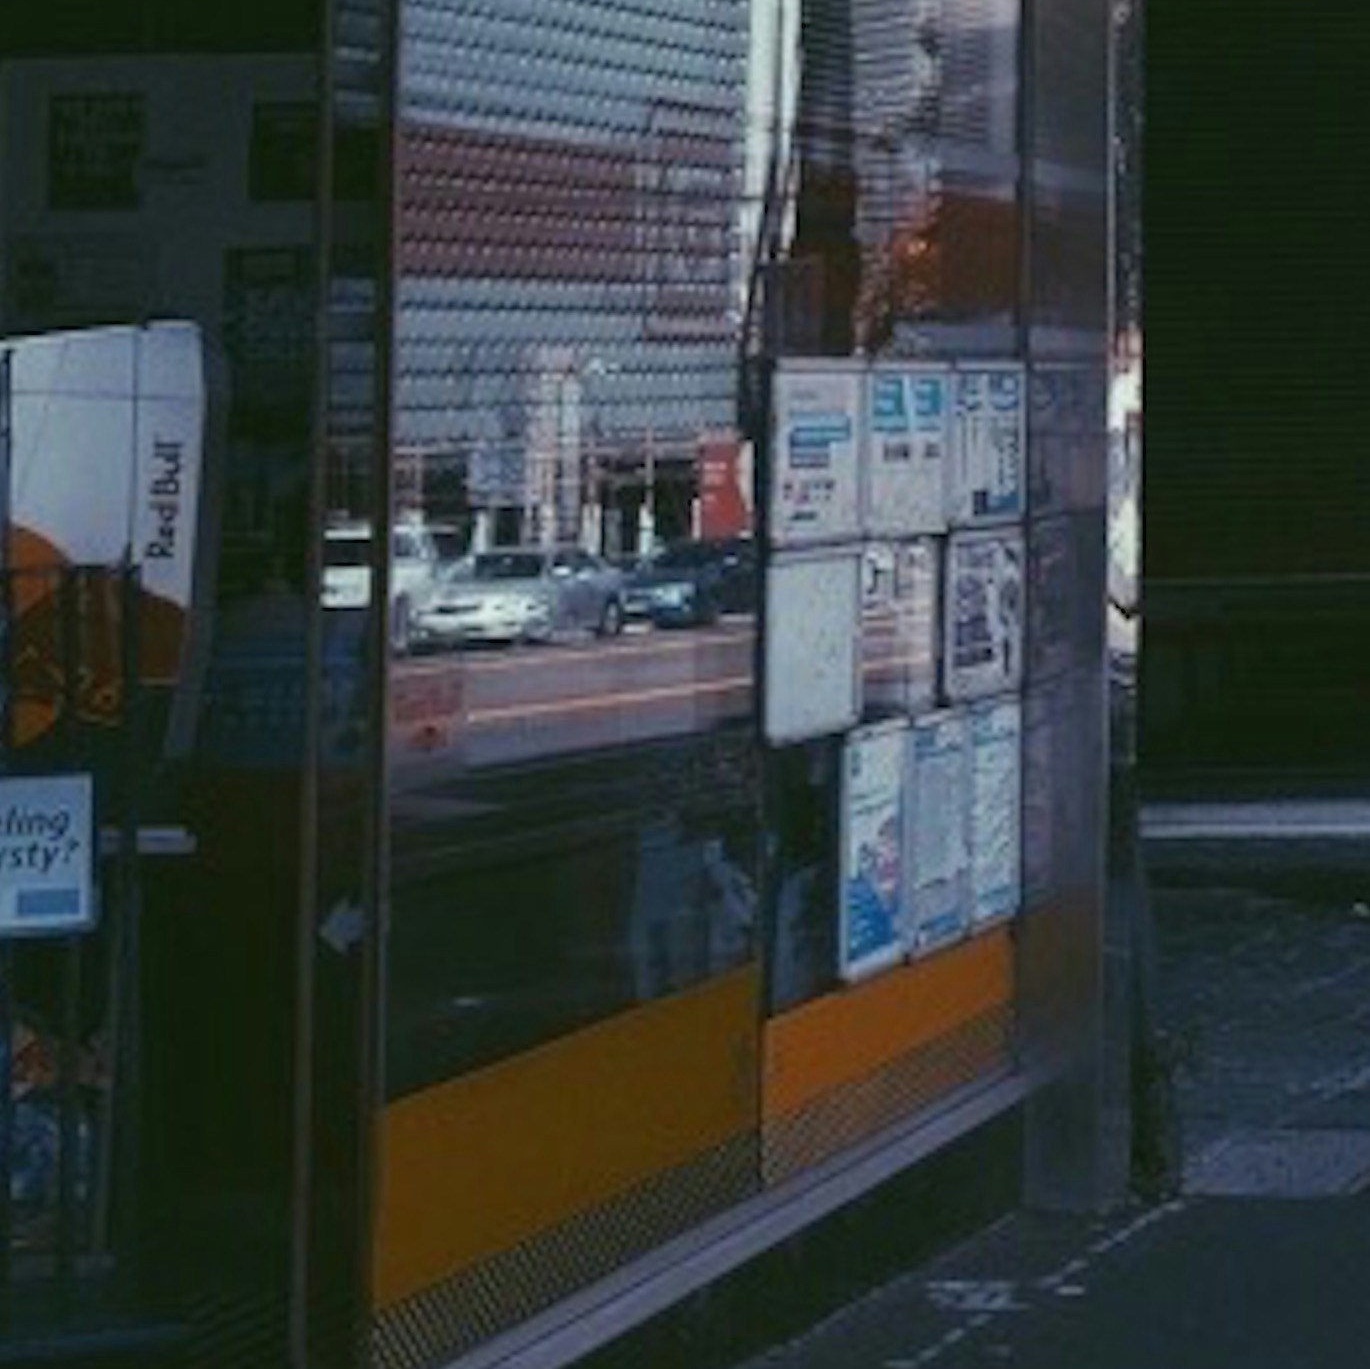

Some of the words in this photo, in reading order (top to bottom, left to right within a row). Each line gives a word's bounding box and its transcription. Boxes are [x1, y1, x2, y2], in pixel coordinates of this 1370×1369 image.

[149, 441, 184, 495] Bull
[144, 500, 178, 559] Red
[0, 806, 70, 842] ling
